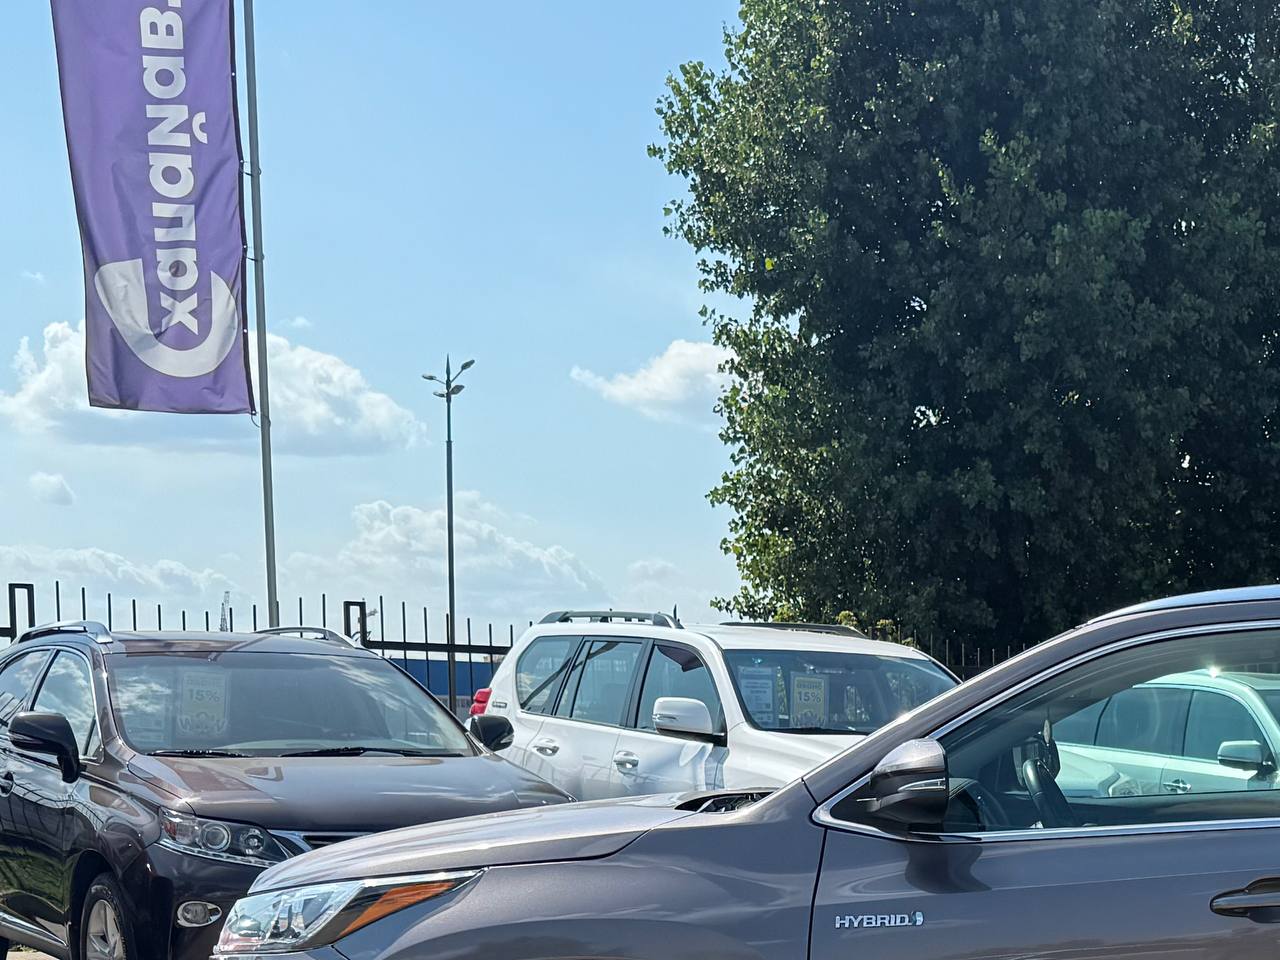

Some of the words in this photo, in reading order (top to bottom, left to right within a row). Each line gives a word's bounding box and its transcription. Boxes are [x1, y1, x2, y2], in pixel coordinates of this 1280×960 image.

[139, 0, 208, 336] хапайав
[188, 688, 221, 703] 15%
[797, 691, 822, 704] 15%
[835, 914, 911, 928] HYBRID
